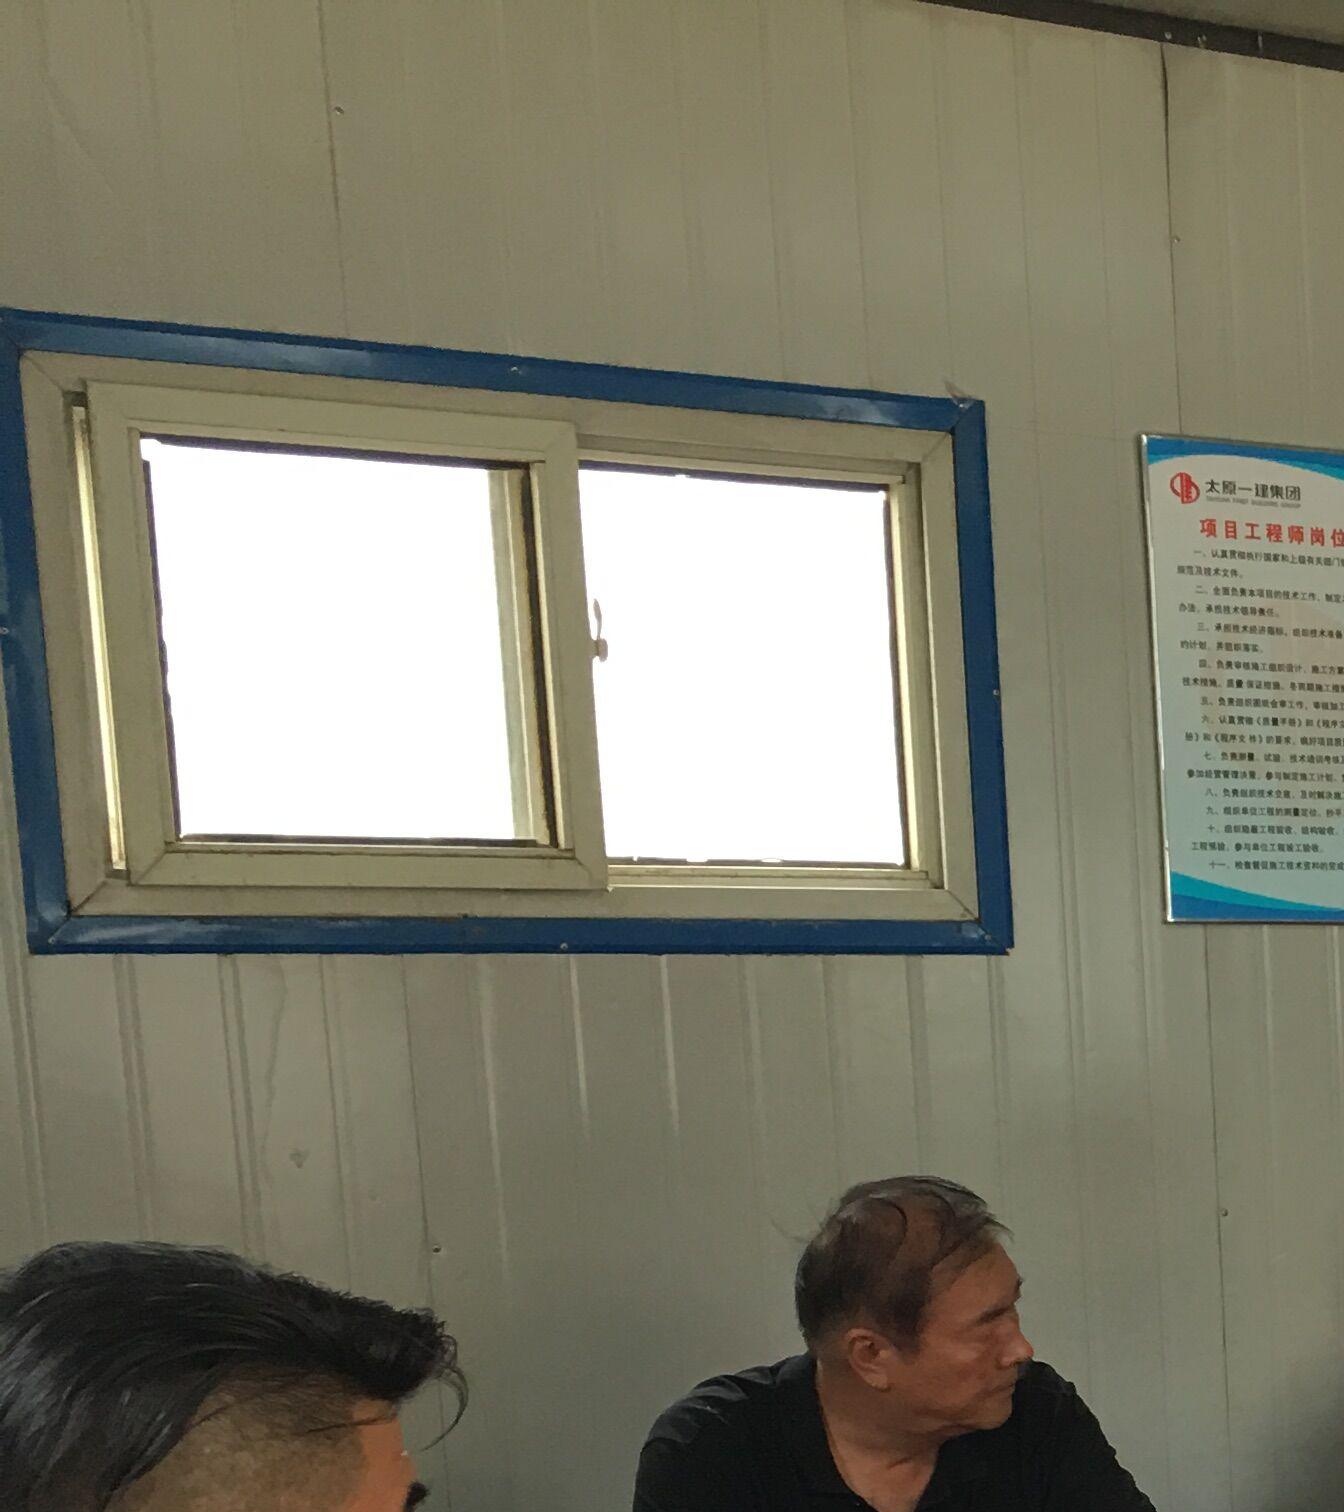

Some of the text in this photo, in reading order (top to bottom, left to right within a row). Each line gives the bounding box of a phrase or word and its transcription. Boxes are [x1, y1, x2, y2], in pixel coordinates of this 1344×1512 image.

[1205, 479, 1301, 501] 太原一建集团
